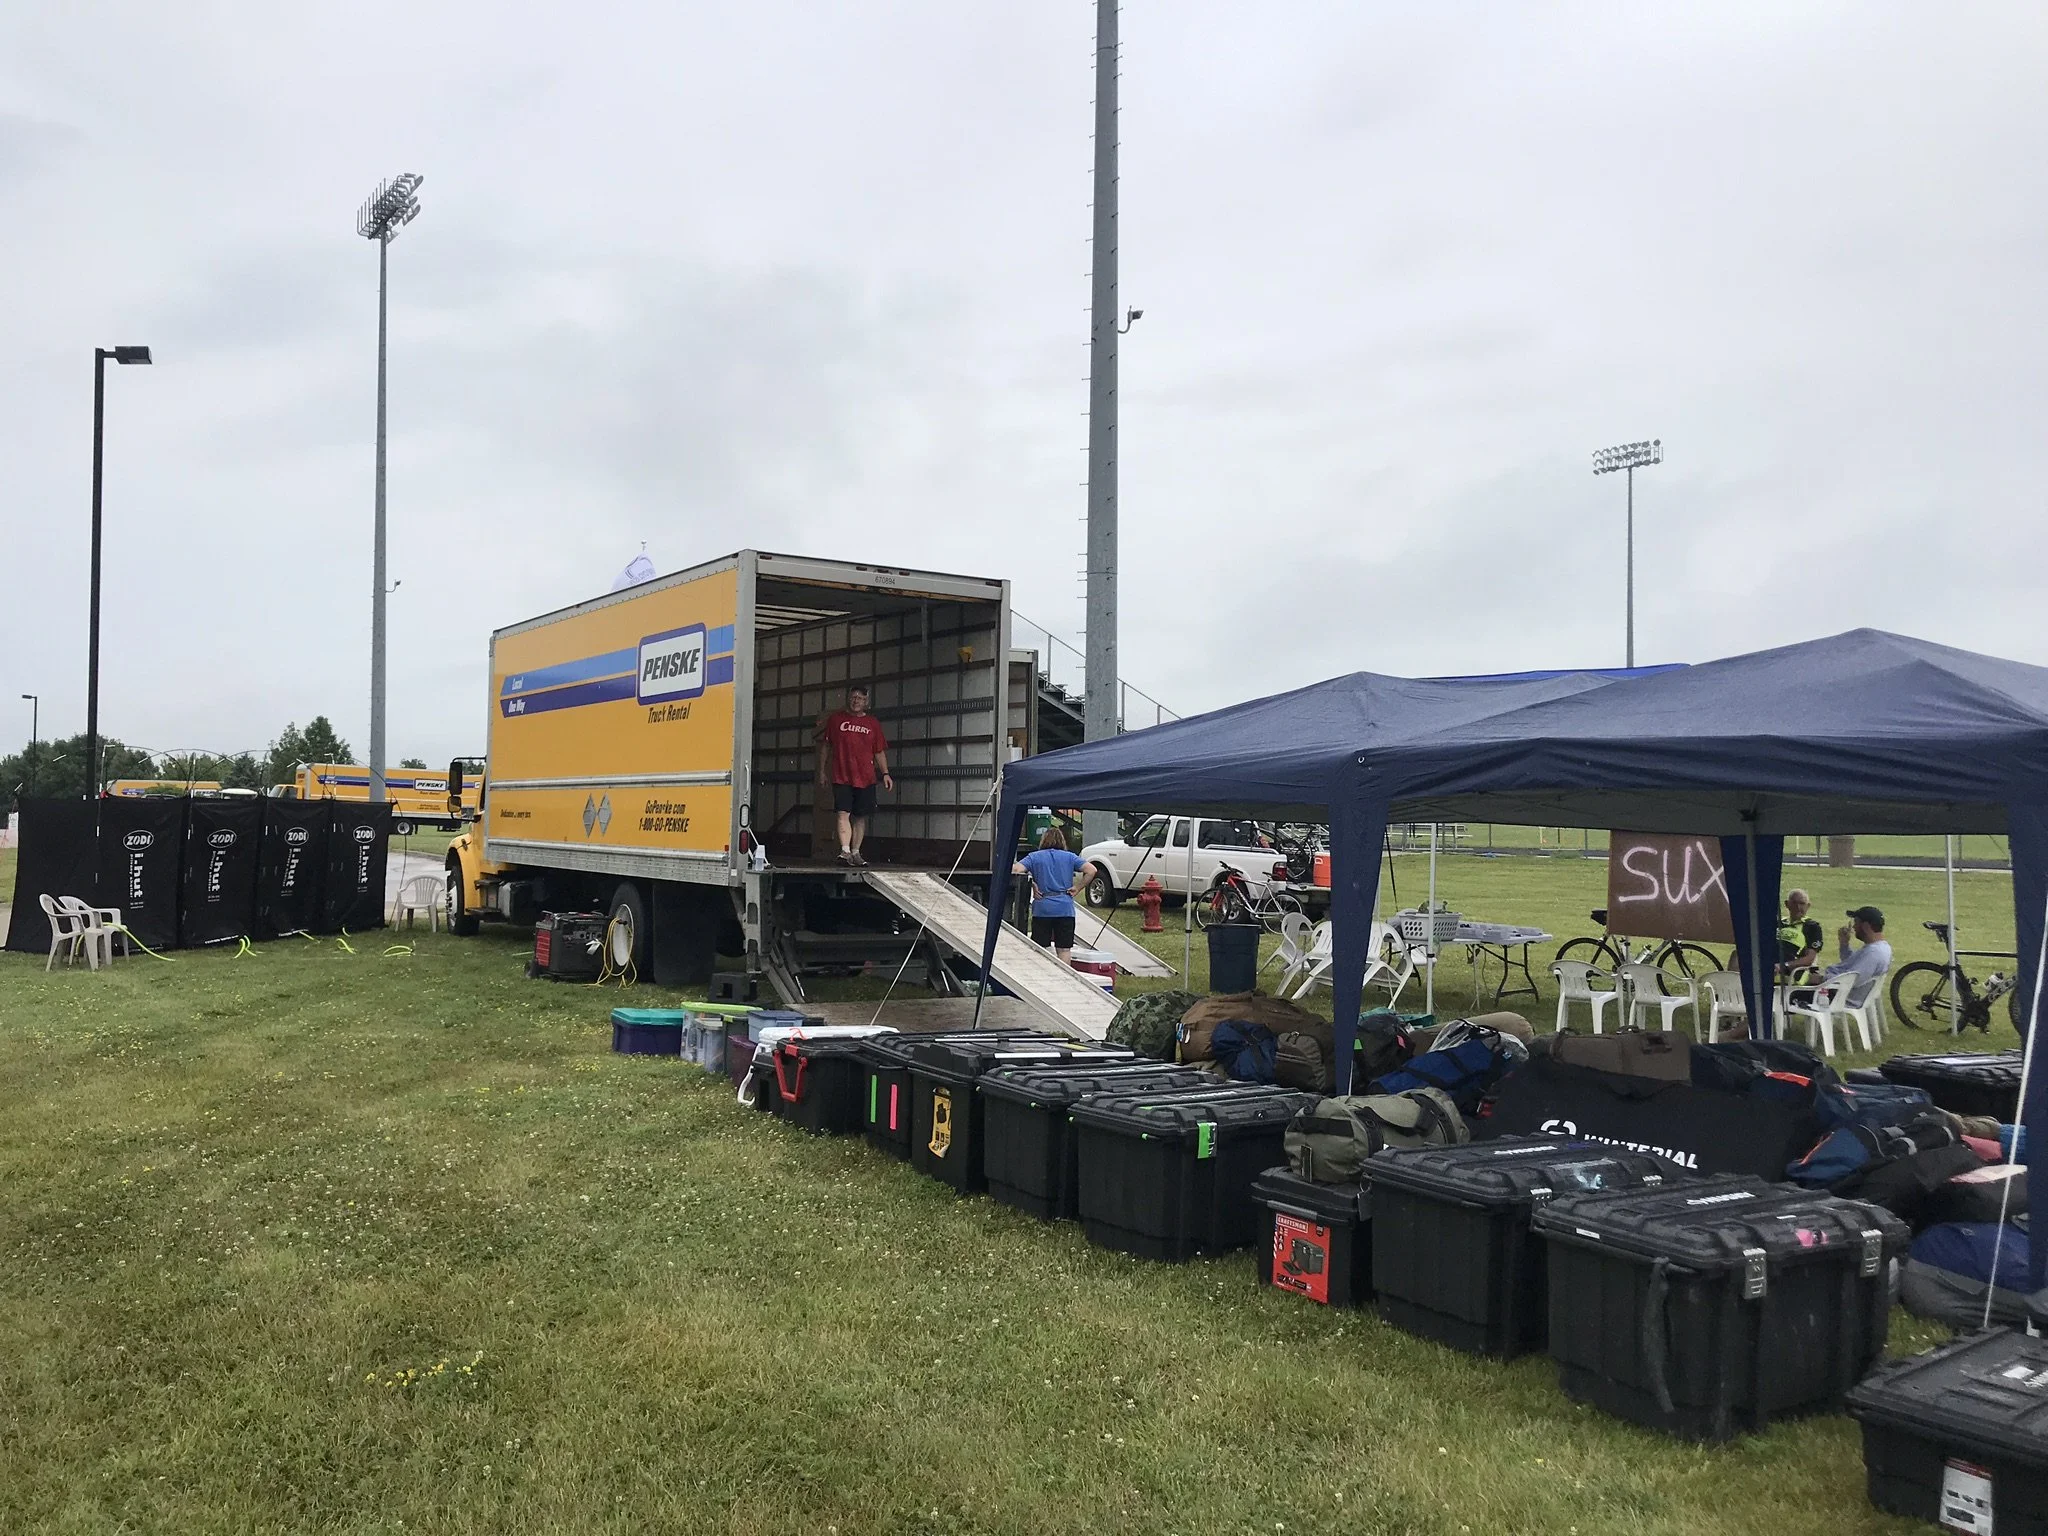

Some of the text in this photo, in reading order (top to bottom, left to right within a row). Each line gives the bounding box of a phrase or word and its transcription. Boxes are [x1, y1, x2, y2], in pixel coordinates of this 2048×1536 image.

[642, 648, 701, 682] PENSKE
[648, 703, 691, 724] Truck Rental
[211, 834, 234, 844] ZODI
[287, 831, 306, 842] ZODI
[355, 830, 373, 839] ZODI
[127, 835, 151, 846] ZODI
[1277, 1216, 1306, 1231] CRAFTSMAN
